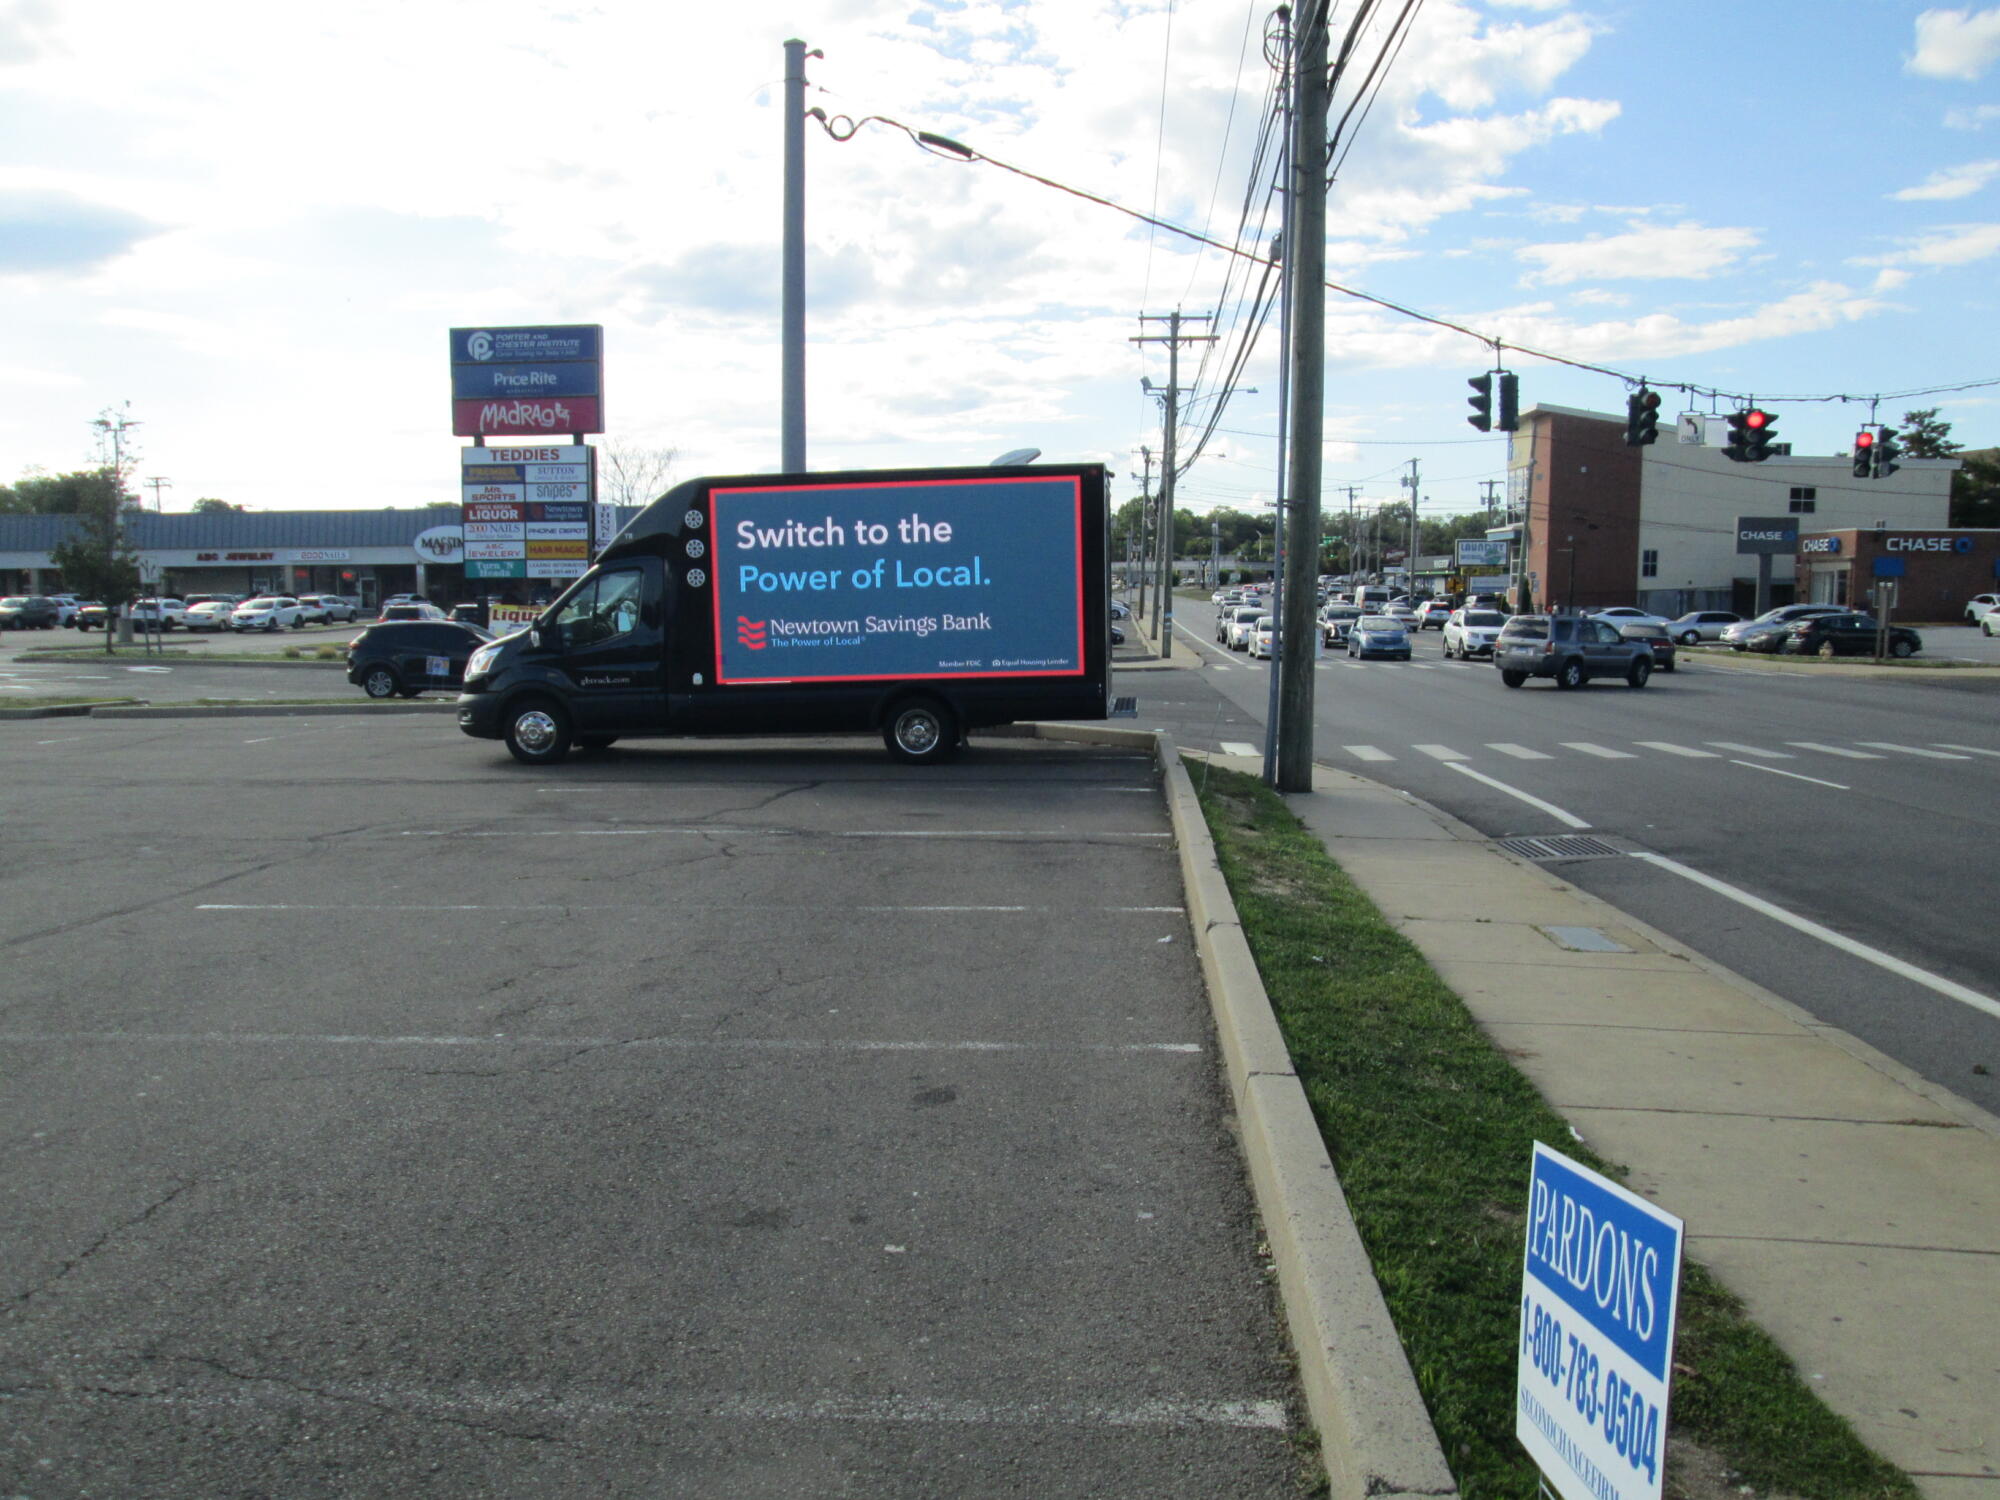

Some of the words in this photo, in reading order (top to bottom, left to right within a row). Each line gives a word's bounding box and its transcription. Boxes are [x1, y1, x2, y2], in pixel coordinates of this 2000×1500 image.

[495, 340, 535, 348] CHESTER
[490, 448, 560, 461] TEDDIES
[471, 493, 516, 501] SPORTS
[469, 509, 518, 520] LIQUOR
[544, 505, 583, 513] Newtown
[736, 516, 845, 549] Switch
[855, 520, 889, 546] to
[898, 513, 952, 544] the
[1740, 530, 1783, 541] CHASE
[1803, 538, 1829, 552] CHASE
[1886, 537, 1952, 551] CHASE
[739, 564, 842, 592] Power
[851, 559, 886, 589] of
[896, 556, 991, 588] Local.
[492, 608, 543, 623] Liqu
[771, 619, 860, 636] Newtown
[865, 615, 938, 637] Savings
[943, 612, 992, 631] Bank
[771, 638, 790, 648] The
[791, 637, 821, 647] Power
[824, 637, 834, 646] of
[1531, 1178, 1658, 1342] PARDONS
[1522, 1294, 1659, 1485] 1-800-783-0504
